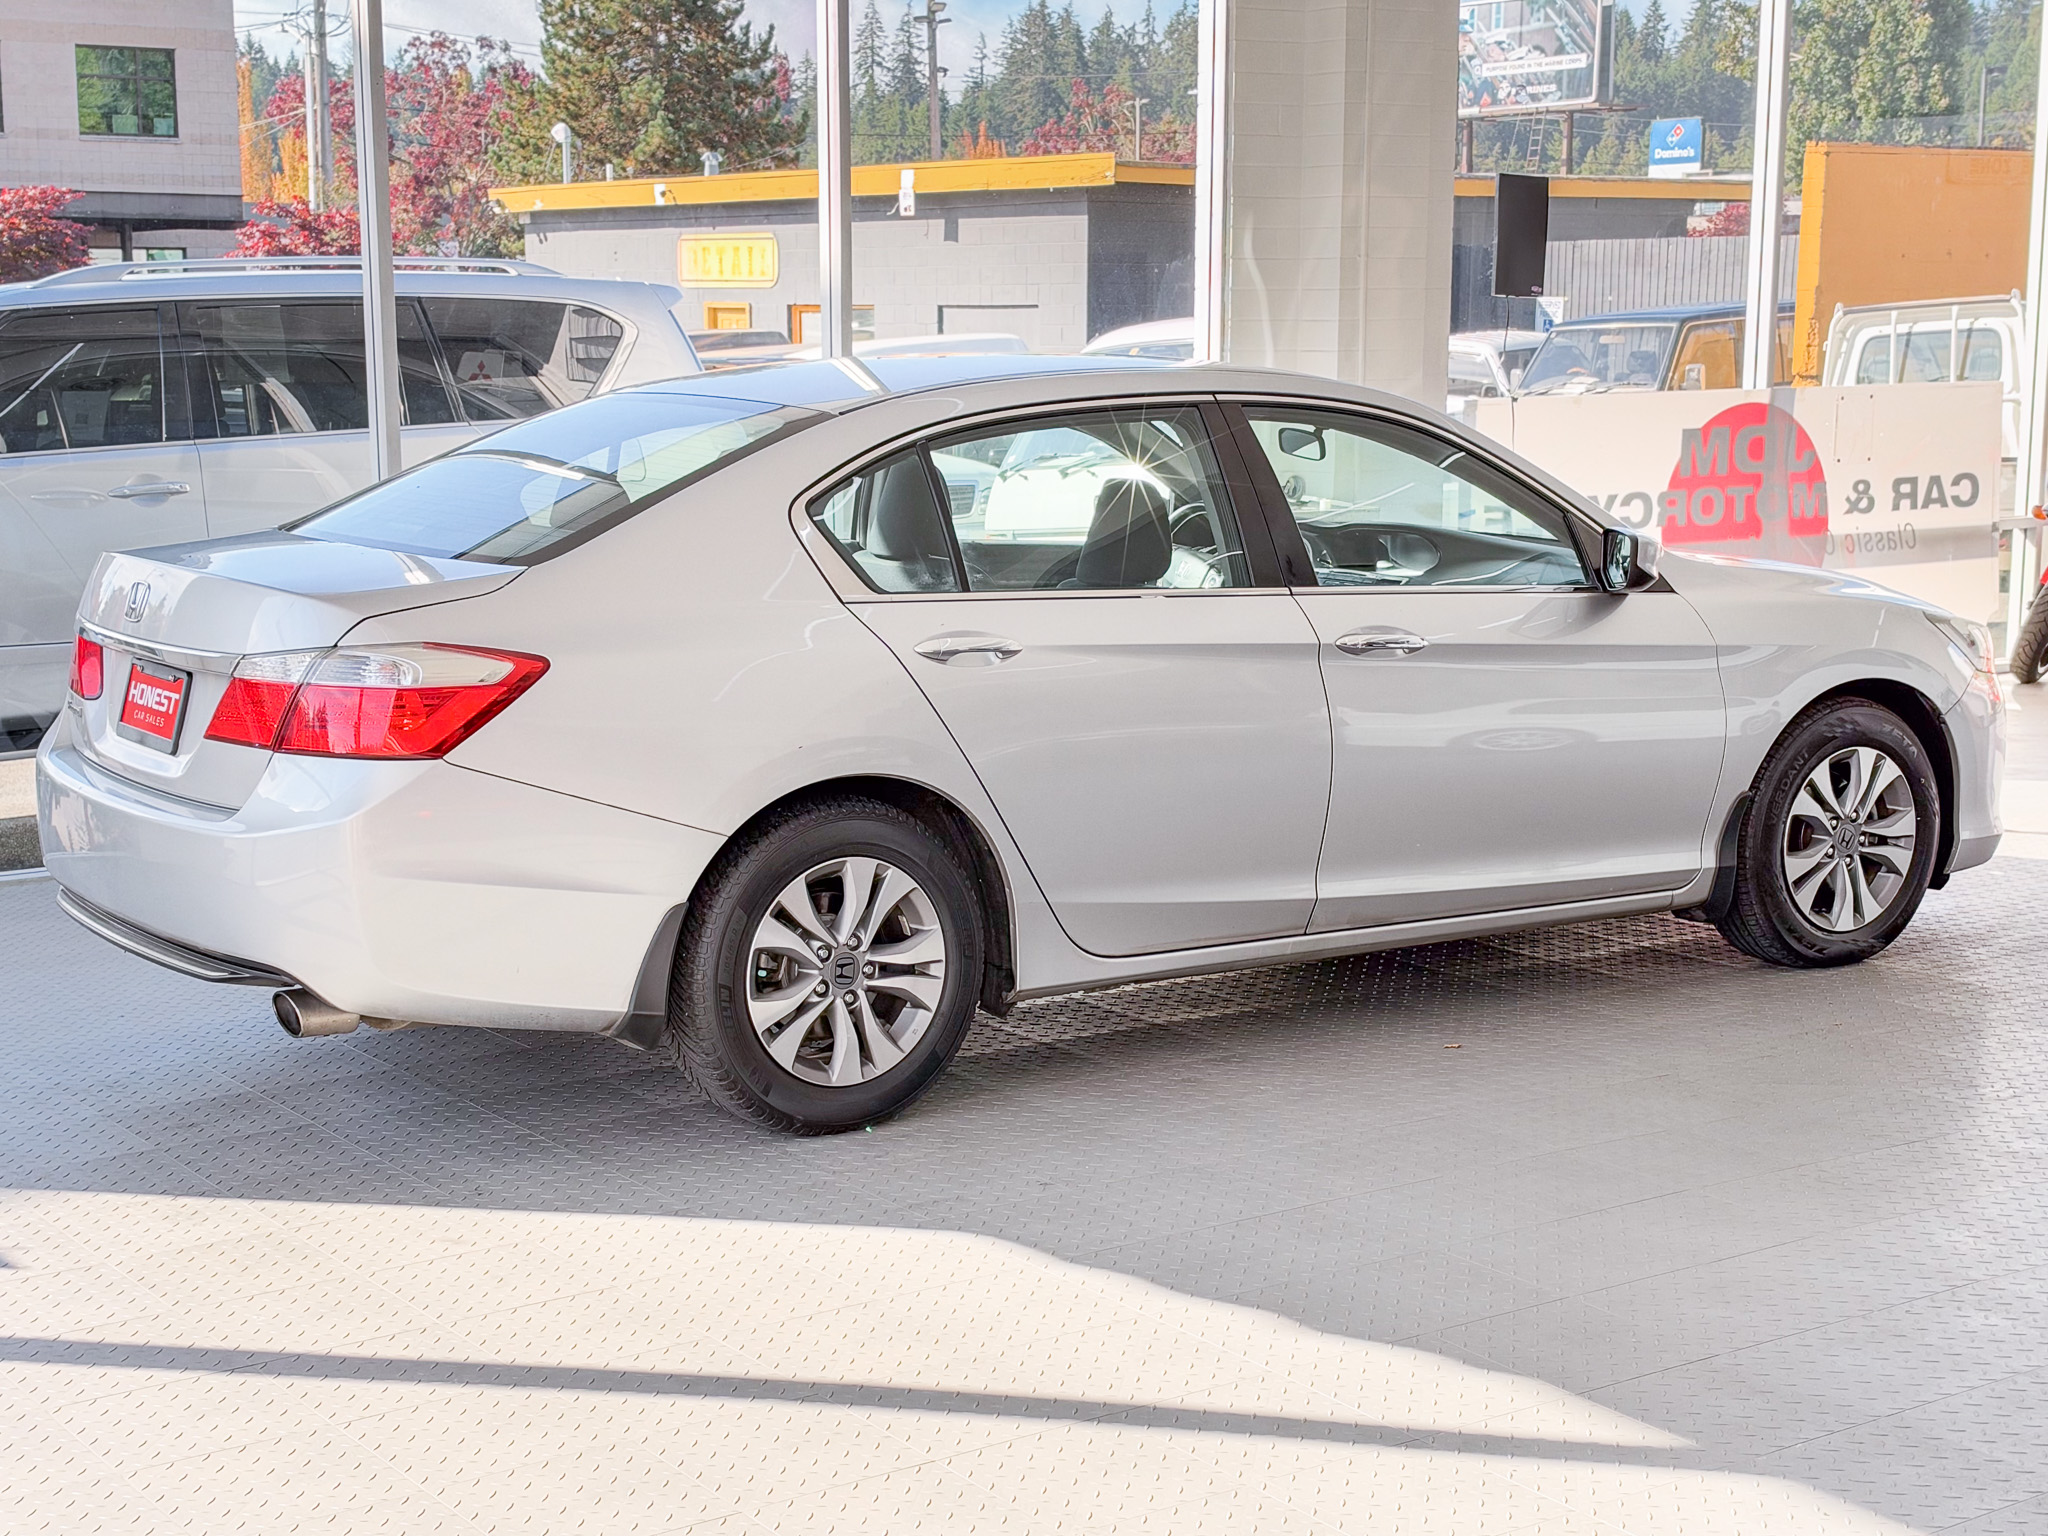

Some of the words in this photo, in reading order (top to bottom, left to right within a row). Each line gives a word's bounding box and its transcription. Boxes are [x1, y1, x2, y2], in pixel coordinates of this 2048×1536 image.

[1509, 63, 1526, 71] FOUND
[1544, 59, 1564, 67] MARINE
[1565, 57, 1583, 65] CORPS
[1526, 83, 1557, 94] RINES
[1654, 146, 1695, 159] Domino's
[128, 680, 180, 715] HONEST
[133, 709, 144, 720] CAR
[145, 713, 165, 727] SALES
